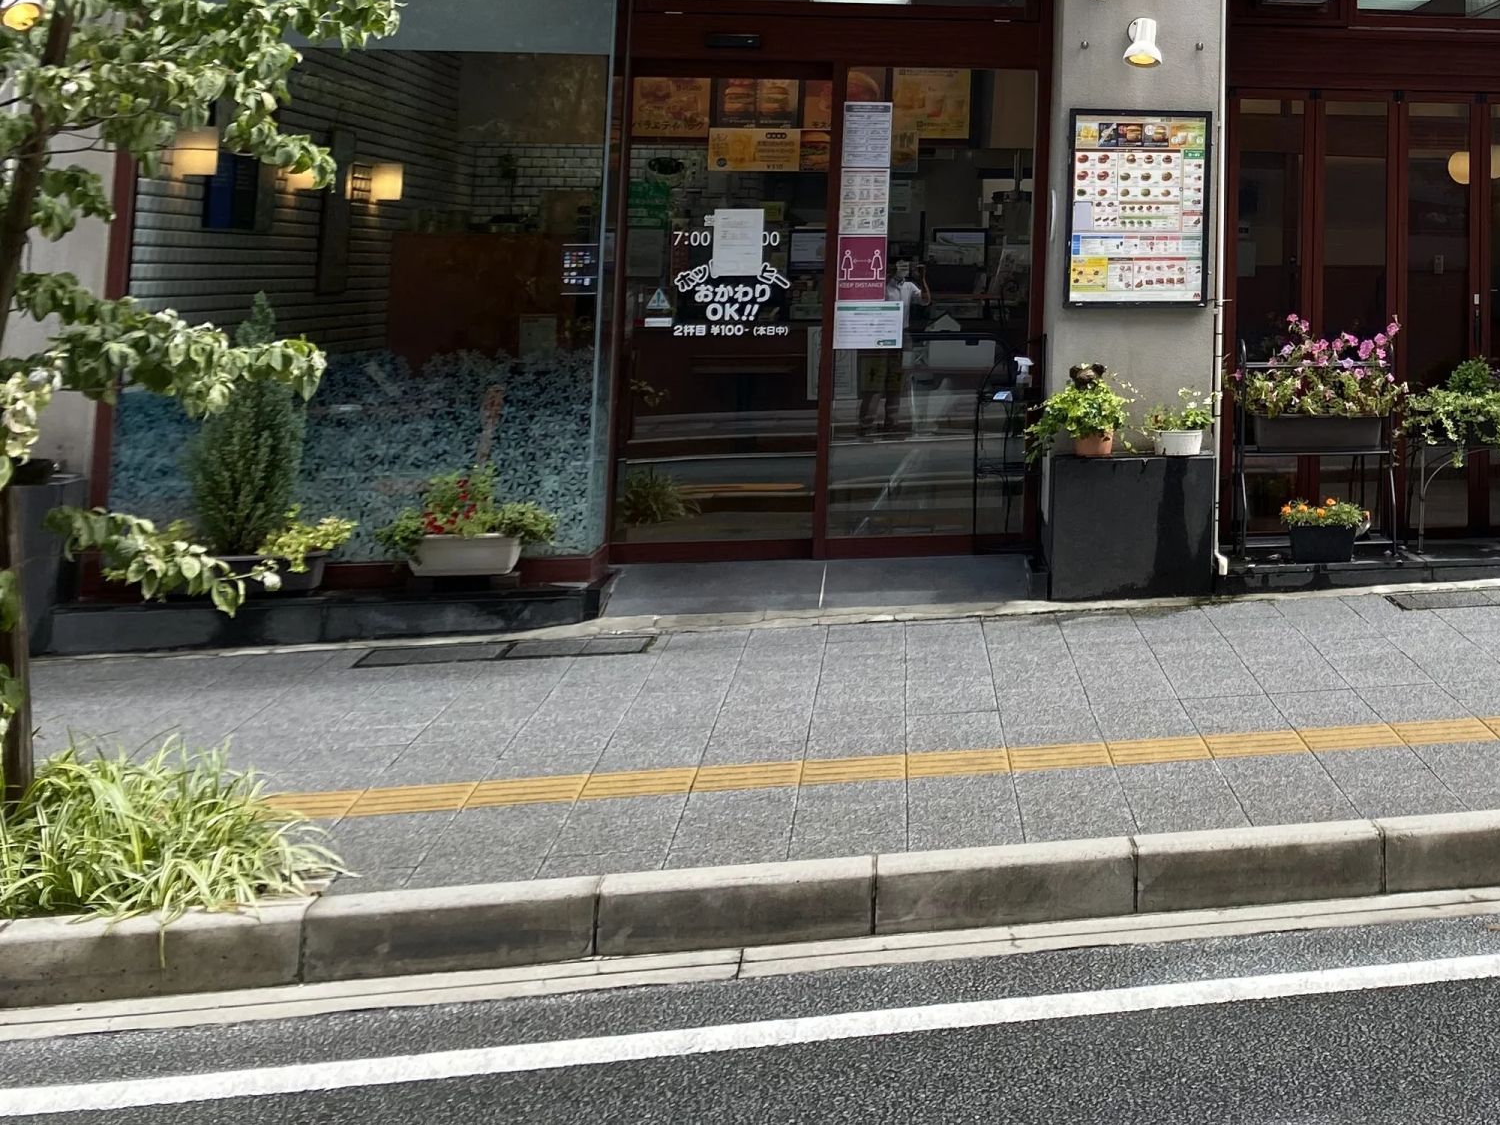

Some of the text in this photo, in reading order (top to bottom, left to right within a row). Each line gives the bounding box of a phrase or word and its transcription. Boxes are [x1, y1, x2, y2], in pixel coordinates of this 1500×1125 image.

[672, 231, 711, 246] 7:00
[694, 284, 771, 303] おかわり
[705, 303, 760, 321] OK!!
[673, 325, 706, 336] 2杯目
